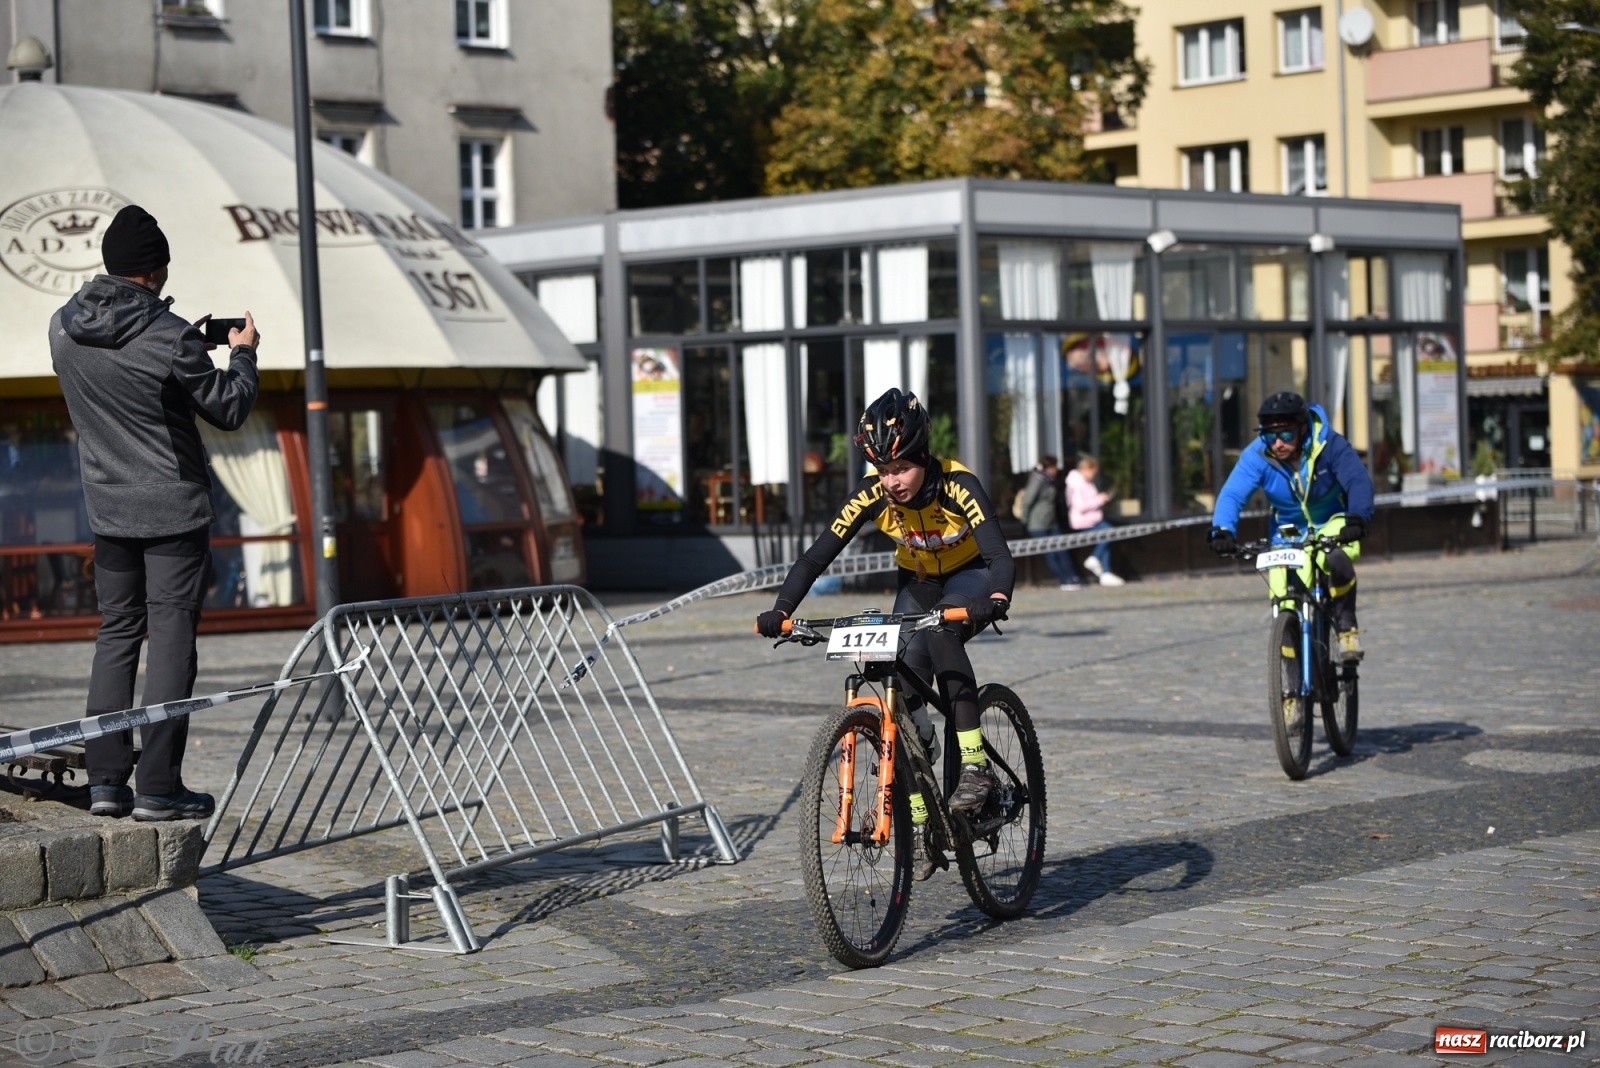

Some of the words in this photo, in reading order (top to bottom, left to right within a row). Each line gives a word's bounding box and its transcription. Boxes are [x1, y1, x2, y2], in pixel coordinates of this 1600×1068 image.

[408, 270, 492, 313] 1567
[831, 481, 884, 539] EVANLIT
[1264, 552, 1297, 564] 3240
[842, 632, 888, 648] 1174
